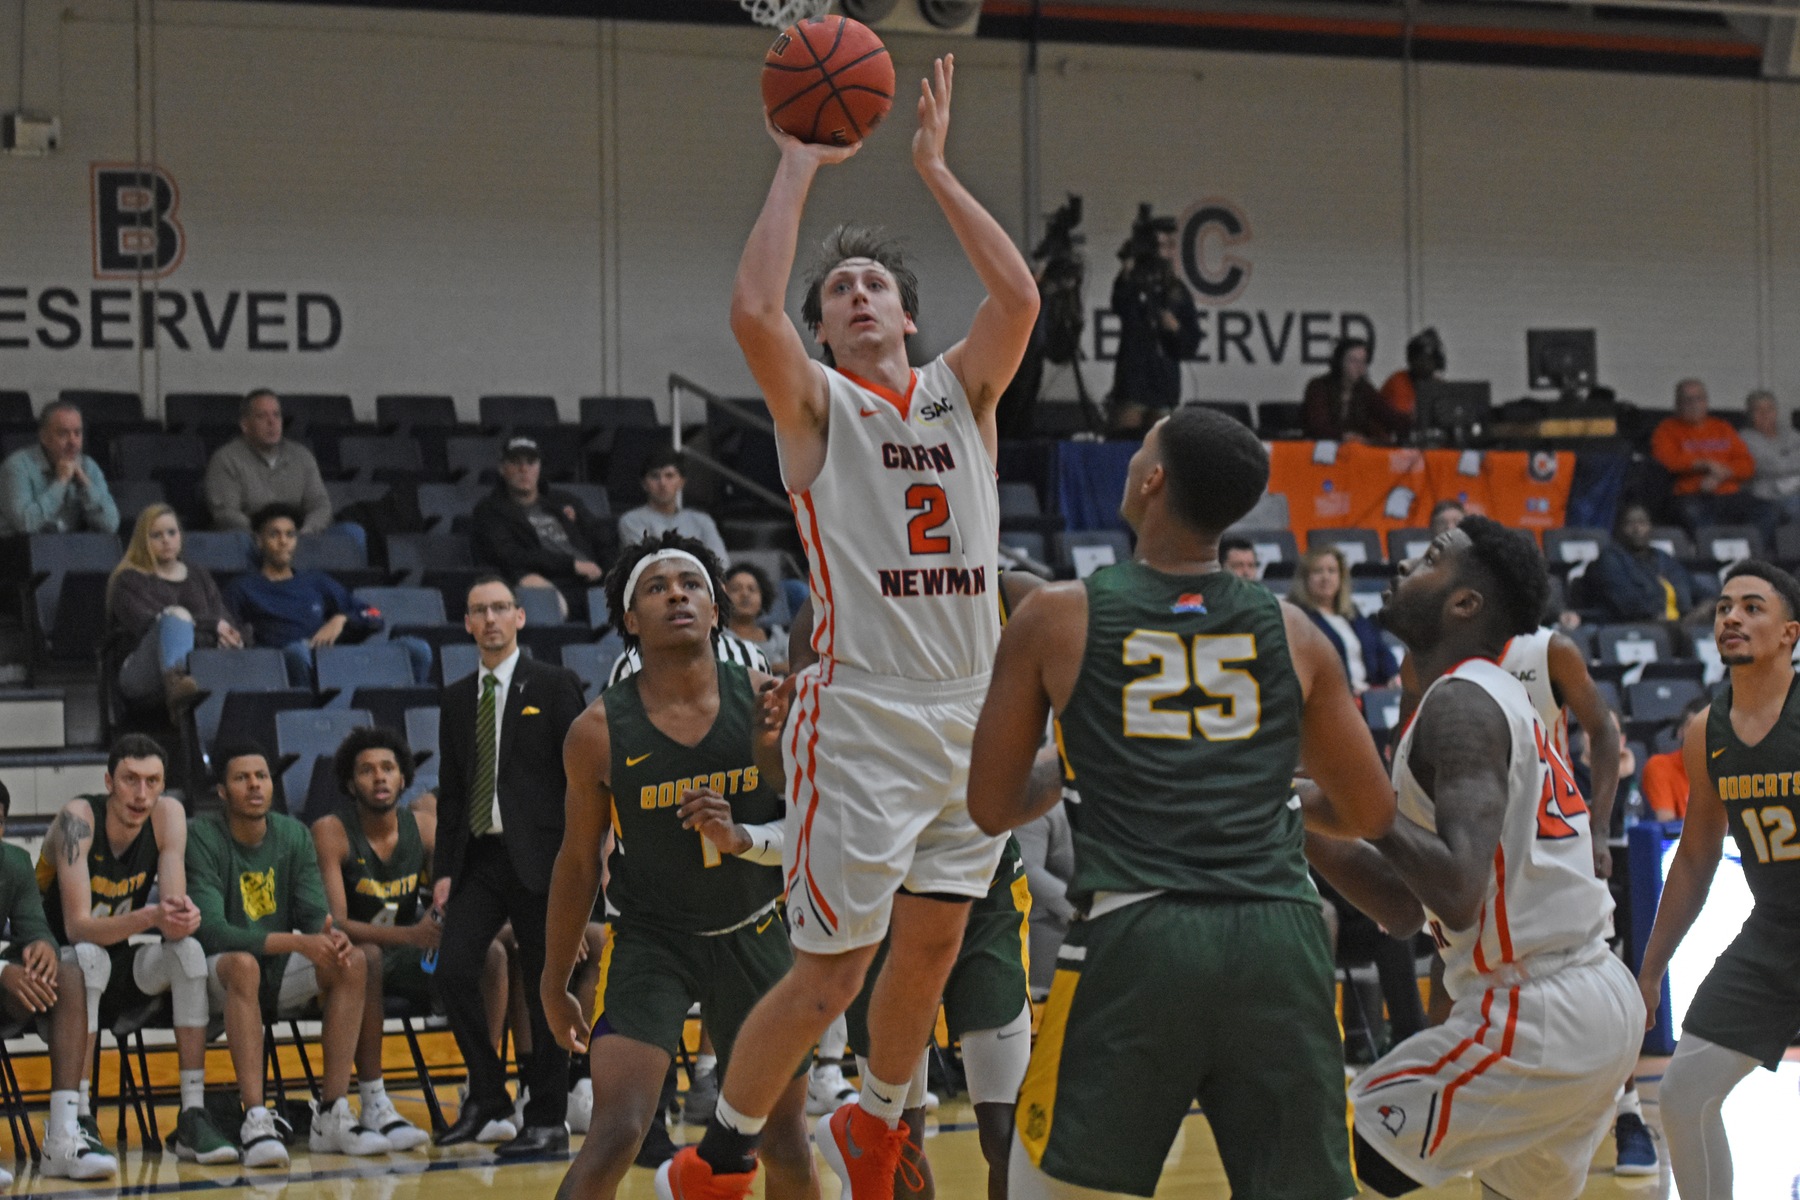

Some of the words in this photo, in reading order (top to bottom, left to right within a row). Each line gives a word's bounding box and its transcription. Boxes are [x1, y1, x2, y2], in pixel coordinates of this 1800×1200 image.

[90, 162, 186, 279] B
[1176, 198, 1252, 304] C
[905, 482, 950, 555] 2
[1122, 628, 1262, 742] 25
[1741, 805, 1800, 863] 12
